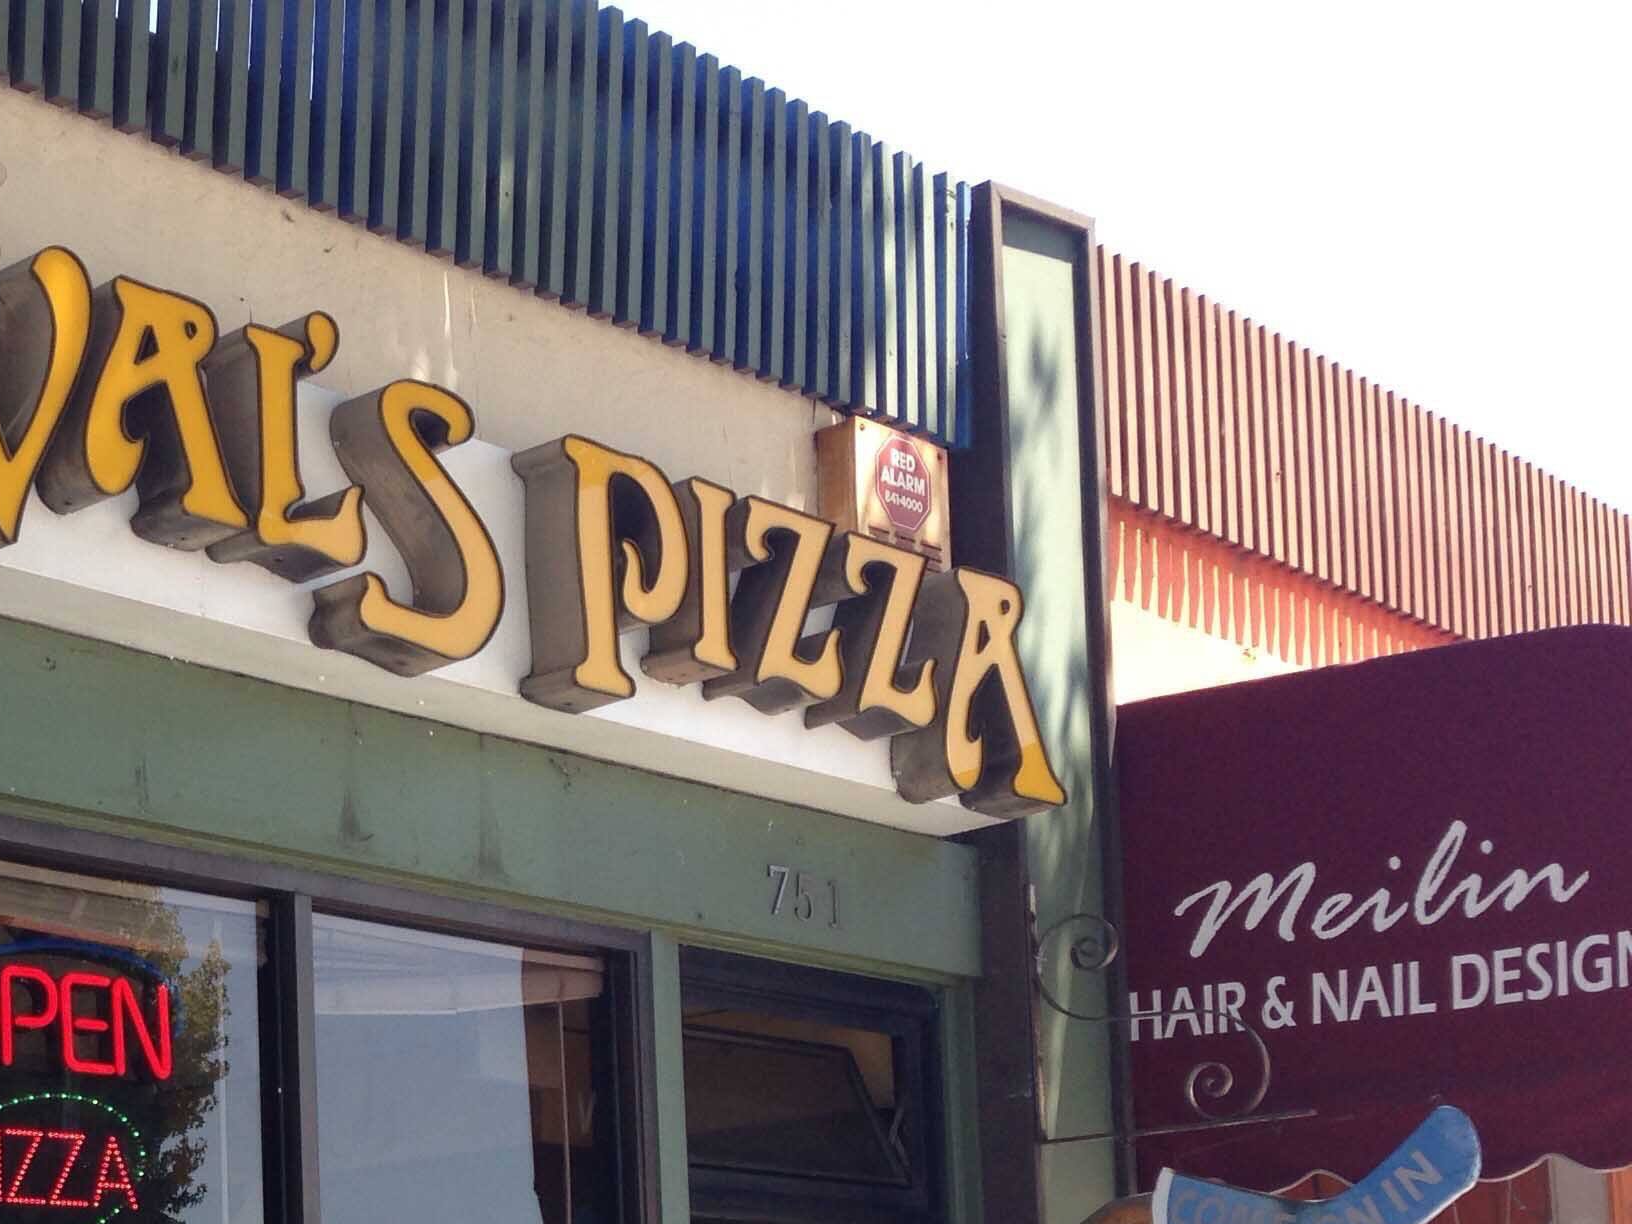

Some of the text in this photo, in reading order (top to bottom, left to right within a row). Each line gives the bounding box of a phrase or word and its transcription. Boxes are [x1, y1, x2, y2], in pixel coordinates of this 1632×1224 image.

[880, 464, 926, 496] ALARM
[891, 447, 916, 472] RED
[563, 433, 1068, 807] PIZZA
[767, 865, 840, 929] 751
[1173, 820, 1590, 958] Meilin
[1129, 981, 1246, 1042] HAIR
[1261, 976, 1297, 1030] &
[1312, 960, 1437, 1027] NAIL
[1381, 1151, 1443, 1213] IN
